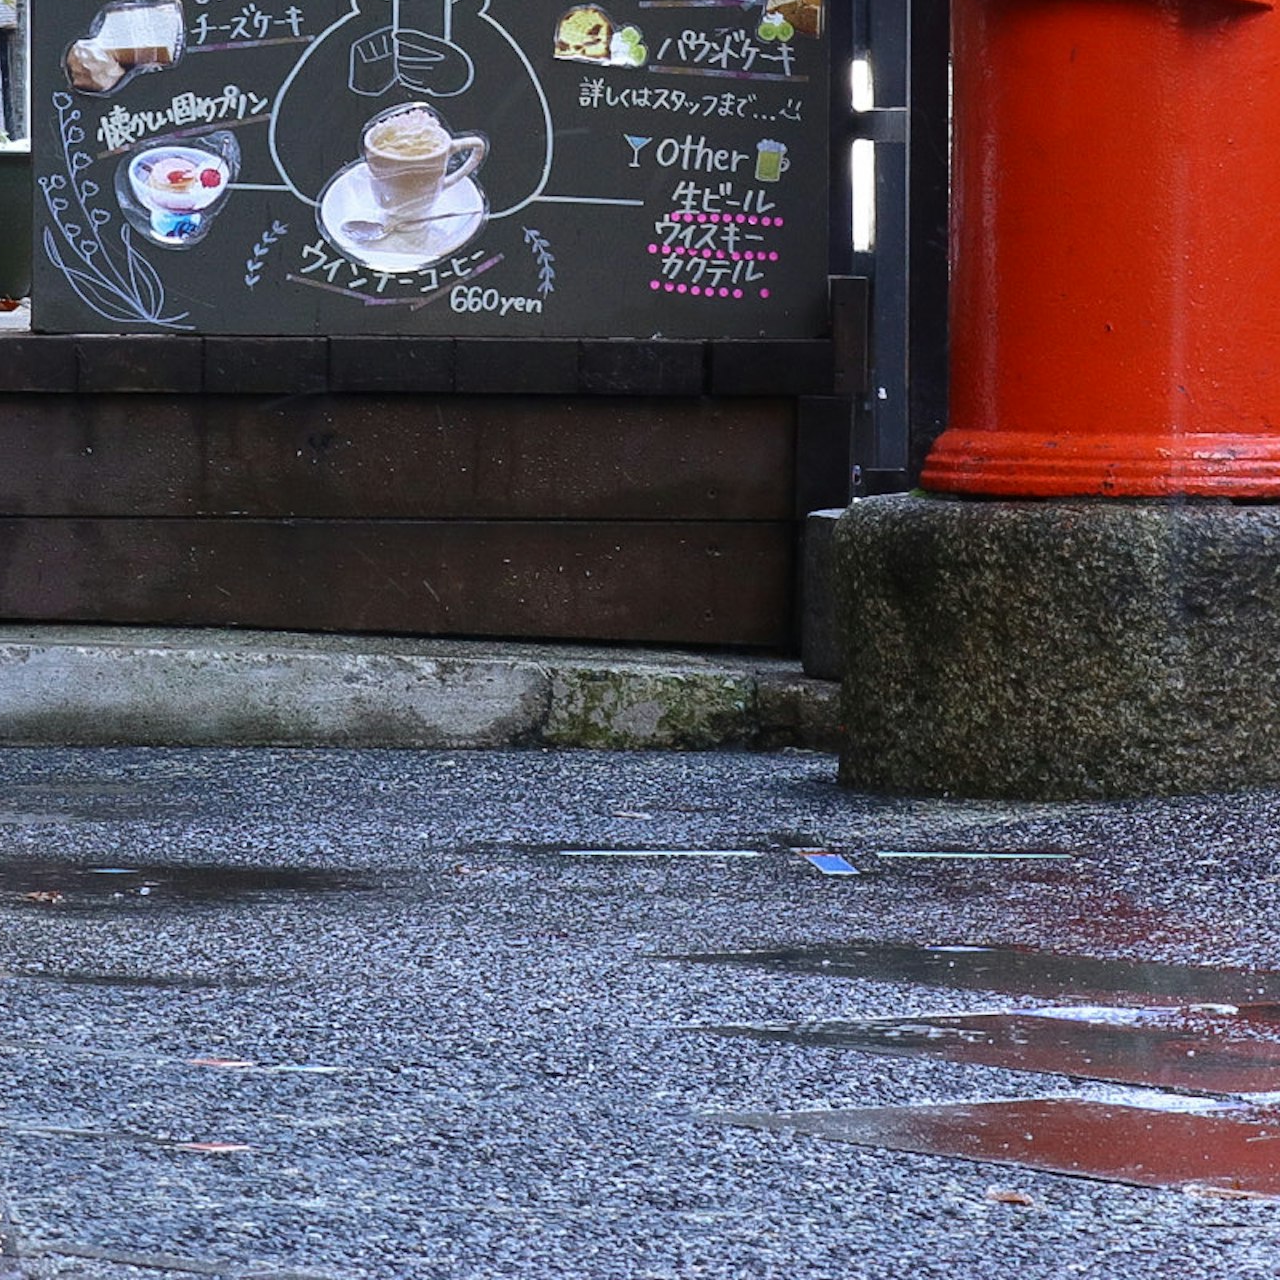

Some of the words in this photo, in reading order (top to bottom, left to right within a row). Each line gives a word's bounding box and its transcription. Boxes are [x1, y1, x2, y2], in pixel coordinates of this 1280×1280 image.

[190, 4, 304, 45] チーズケーキ
[657, 28, 796, 77] パウンドケーキ
[656, 134, 750, 173] Other
[671, 180, 776, 215] 生ビール
[662, 252, 765, 287] カクテル
[450, 285, 544, 316] 660yen
